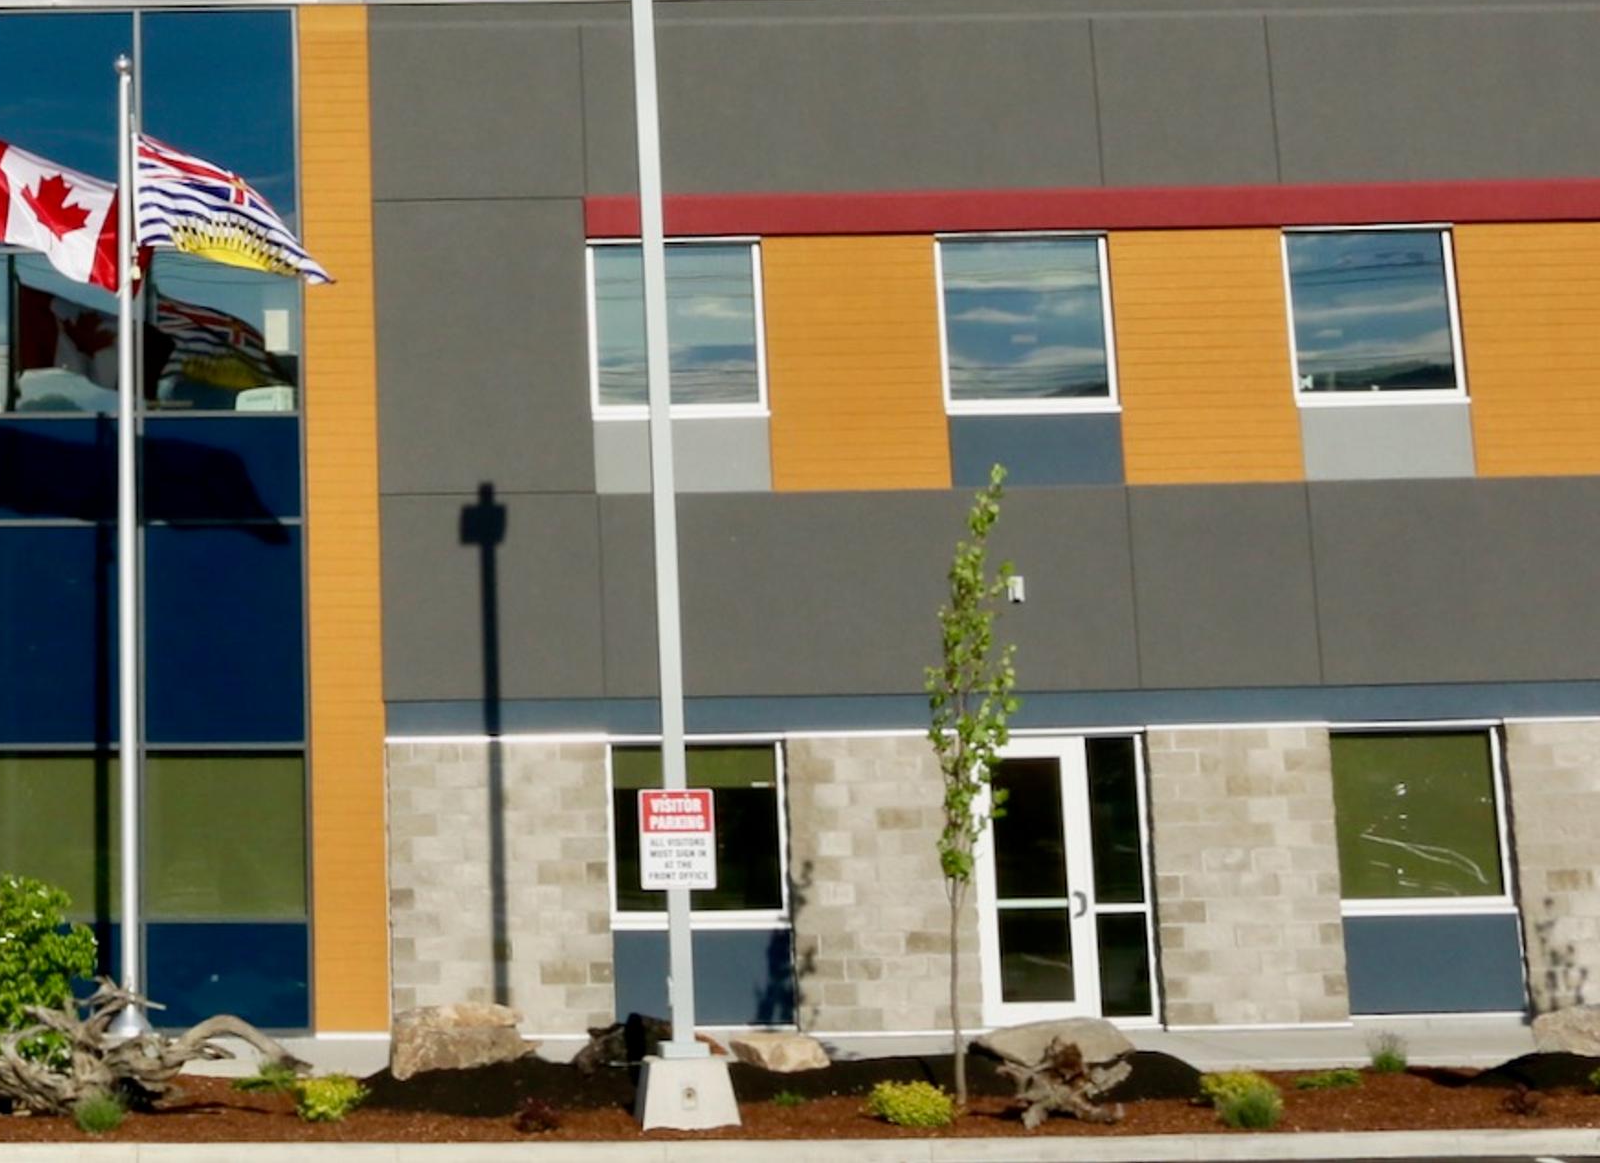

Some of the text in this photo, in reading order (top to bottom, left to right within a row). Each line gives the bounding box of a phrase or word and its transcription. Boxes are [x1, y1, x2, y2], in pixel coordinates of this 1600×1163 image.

[650, 798, 702, 813] VISITOR
[649, 814, 706, 830] PARKING
[667, 838, 705, 848] VISITORS
[650, 849, 707, 858] MUST SIGN IN
[676, 860, 692, 869] THE
[648, 871, 708, 881] FRONT OFFICE
